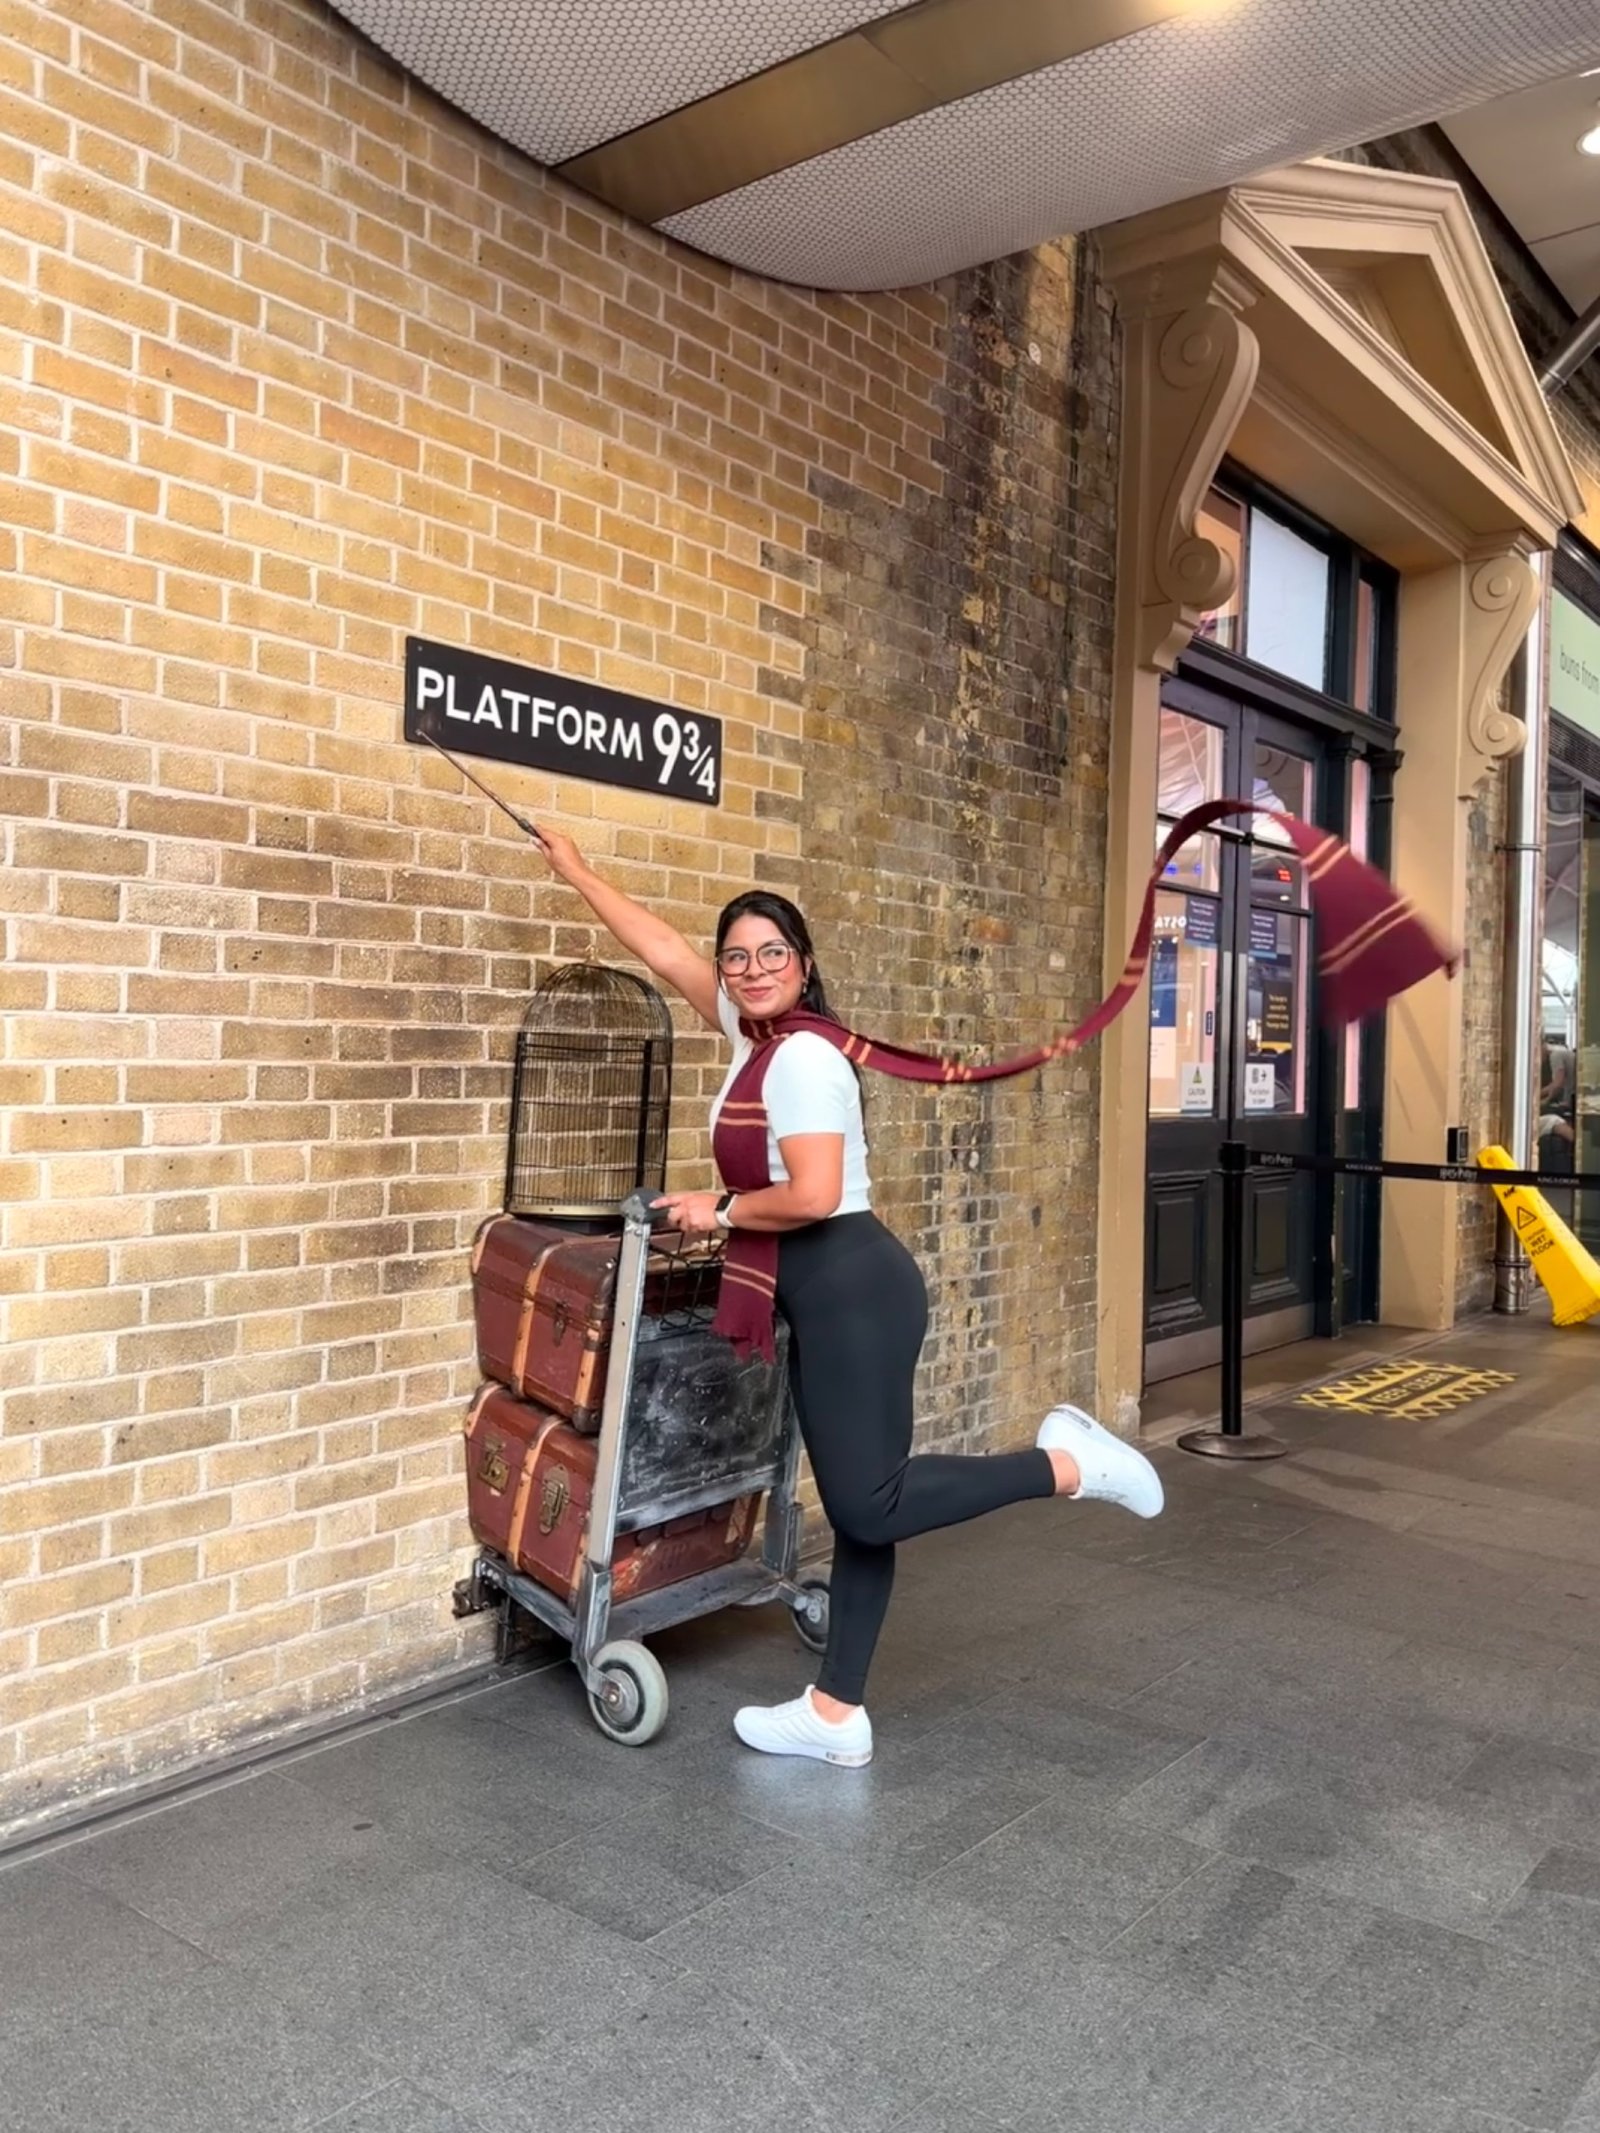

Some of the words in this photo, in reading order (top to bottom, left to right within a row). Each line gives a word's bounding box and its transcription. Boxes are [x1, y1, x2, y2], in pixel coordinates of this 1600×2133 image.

[416, 666, 644, 762] PLATFORM
[1530, 1234, 1546, 1247] WET
[1530, 1239, 1555, 1257] FLOOR
